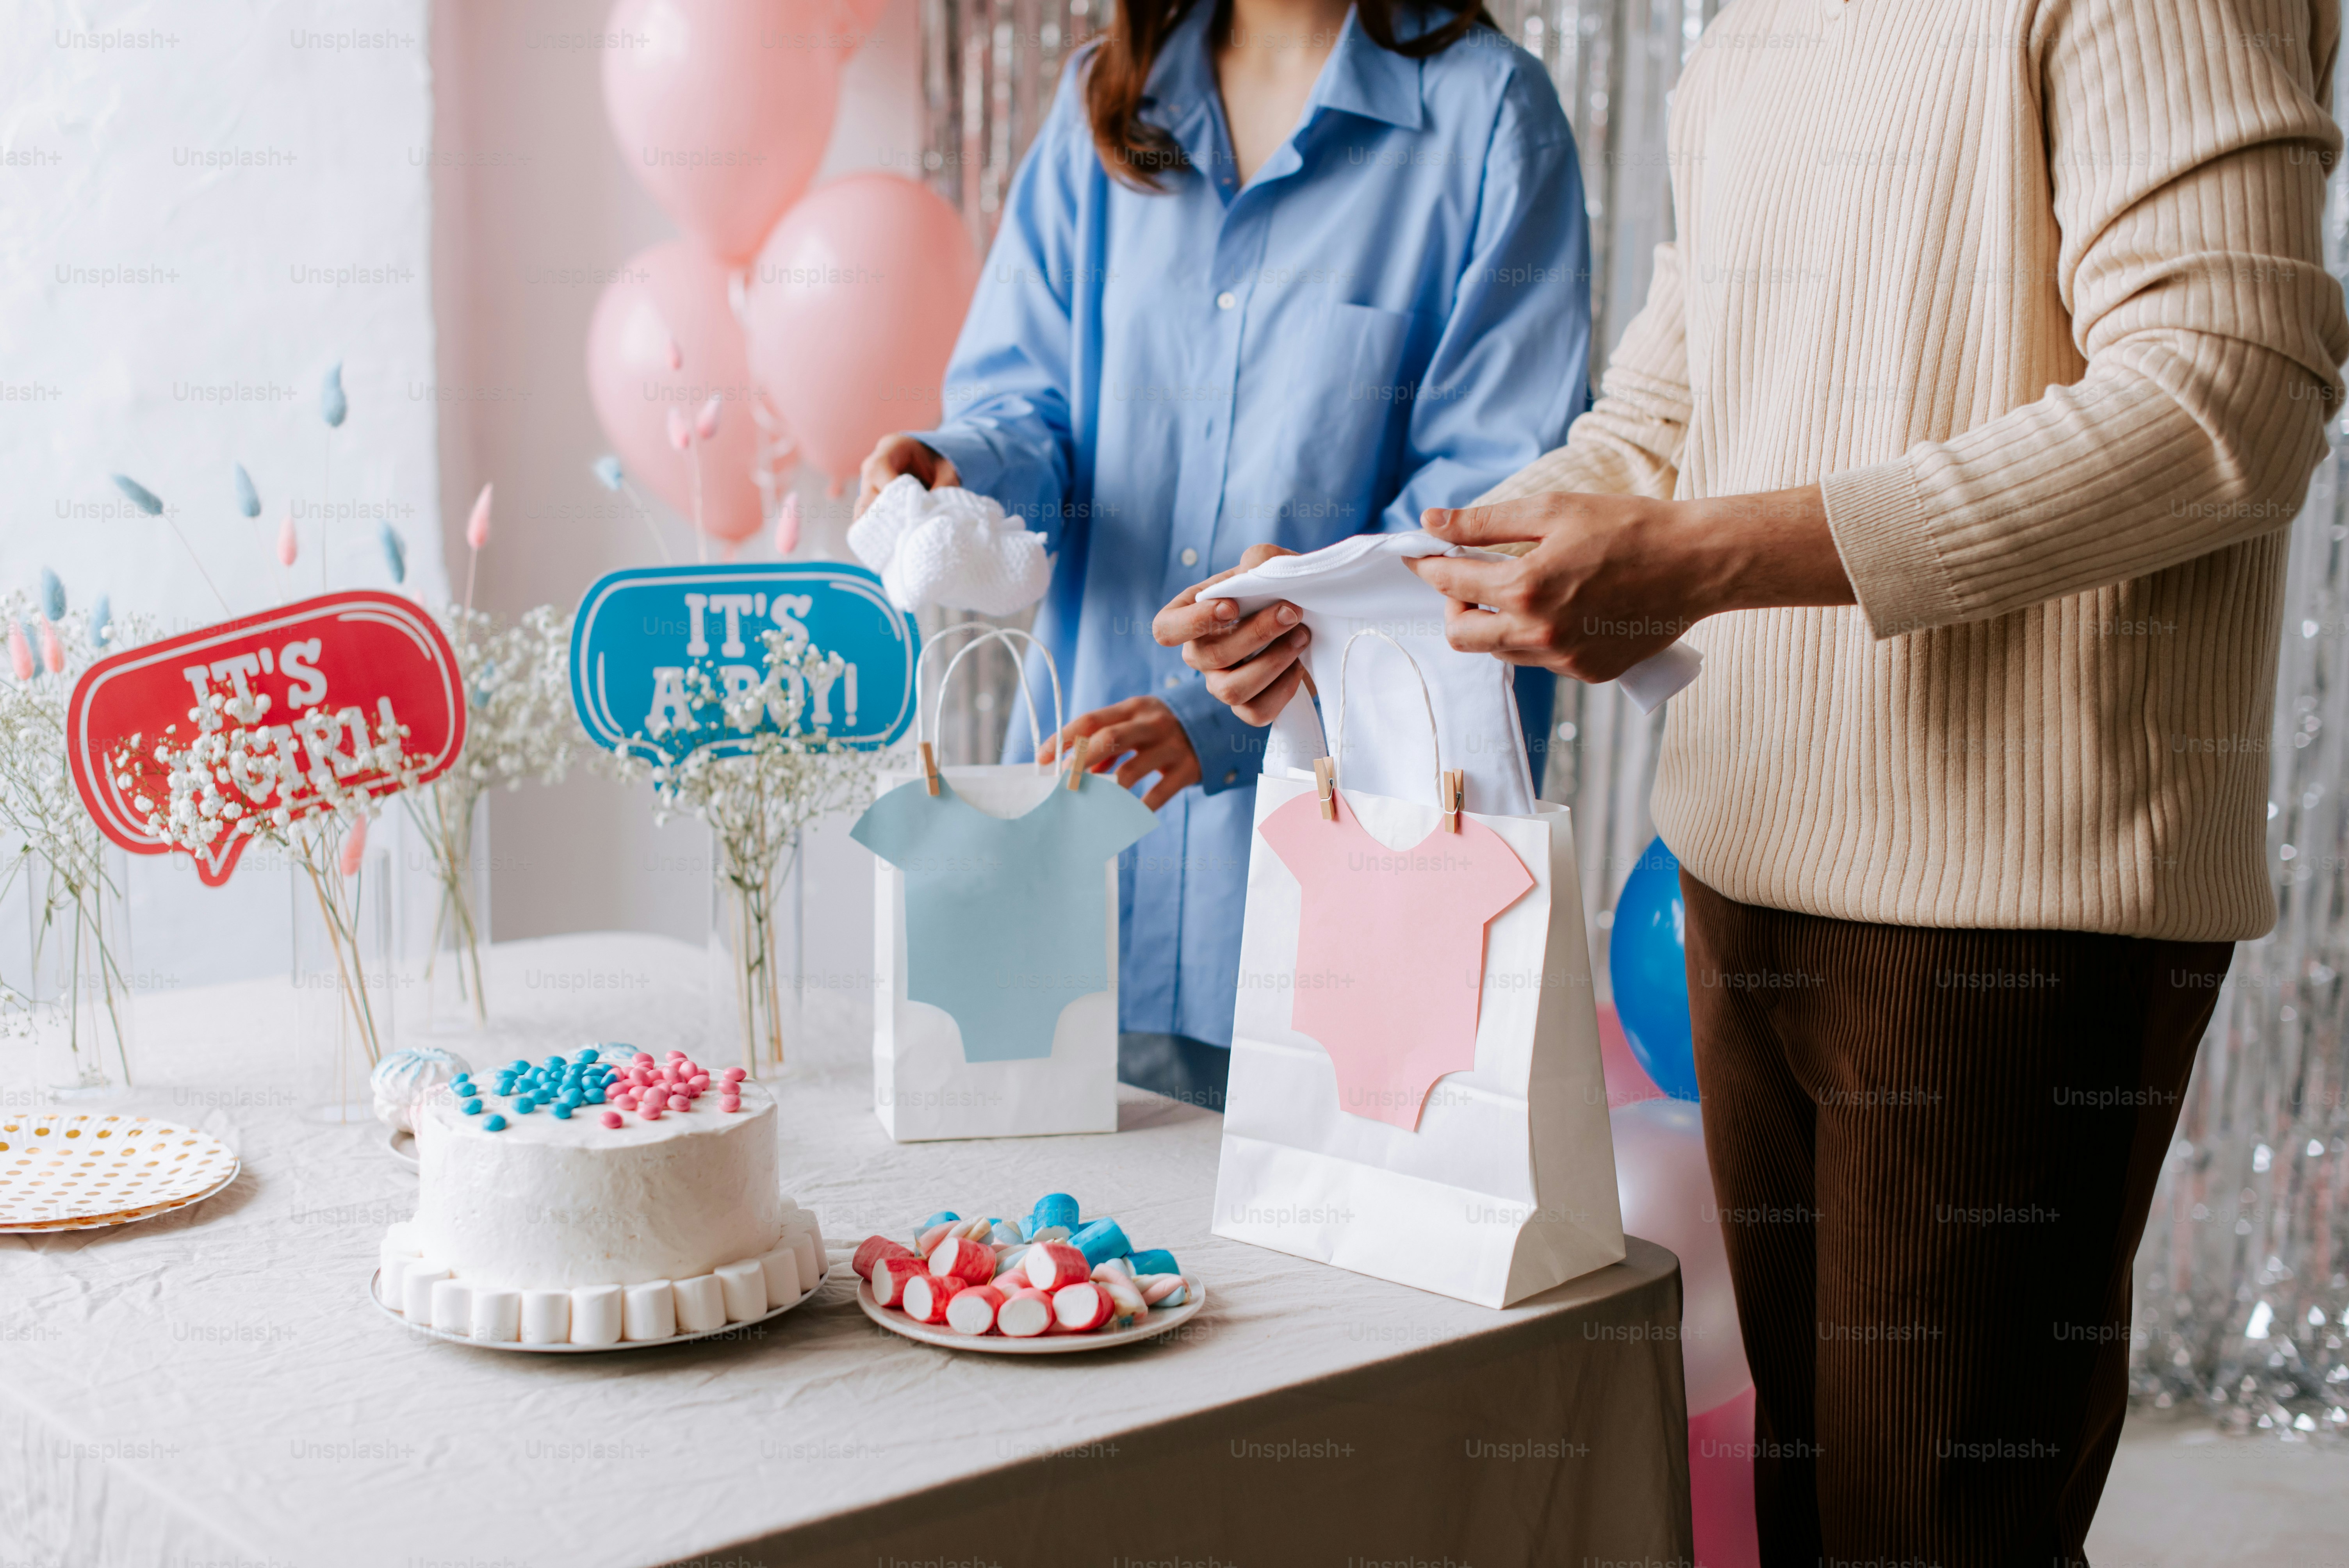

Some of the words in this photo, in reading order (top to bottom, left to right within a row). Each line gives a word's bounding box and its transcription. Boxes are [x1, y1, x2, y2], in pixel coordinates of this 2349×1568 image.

[684, 592, 813, 660] IT'S
[183, 638, 328, 731] IT'S
[644, 666, 700, 729] A
